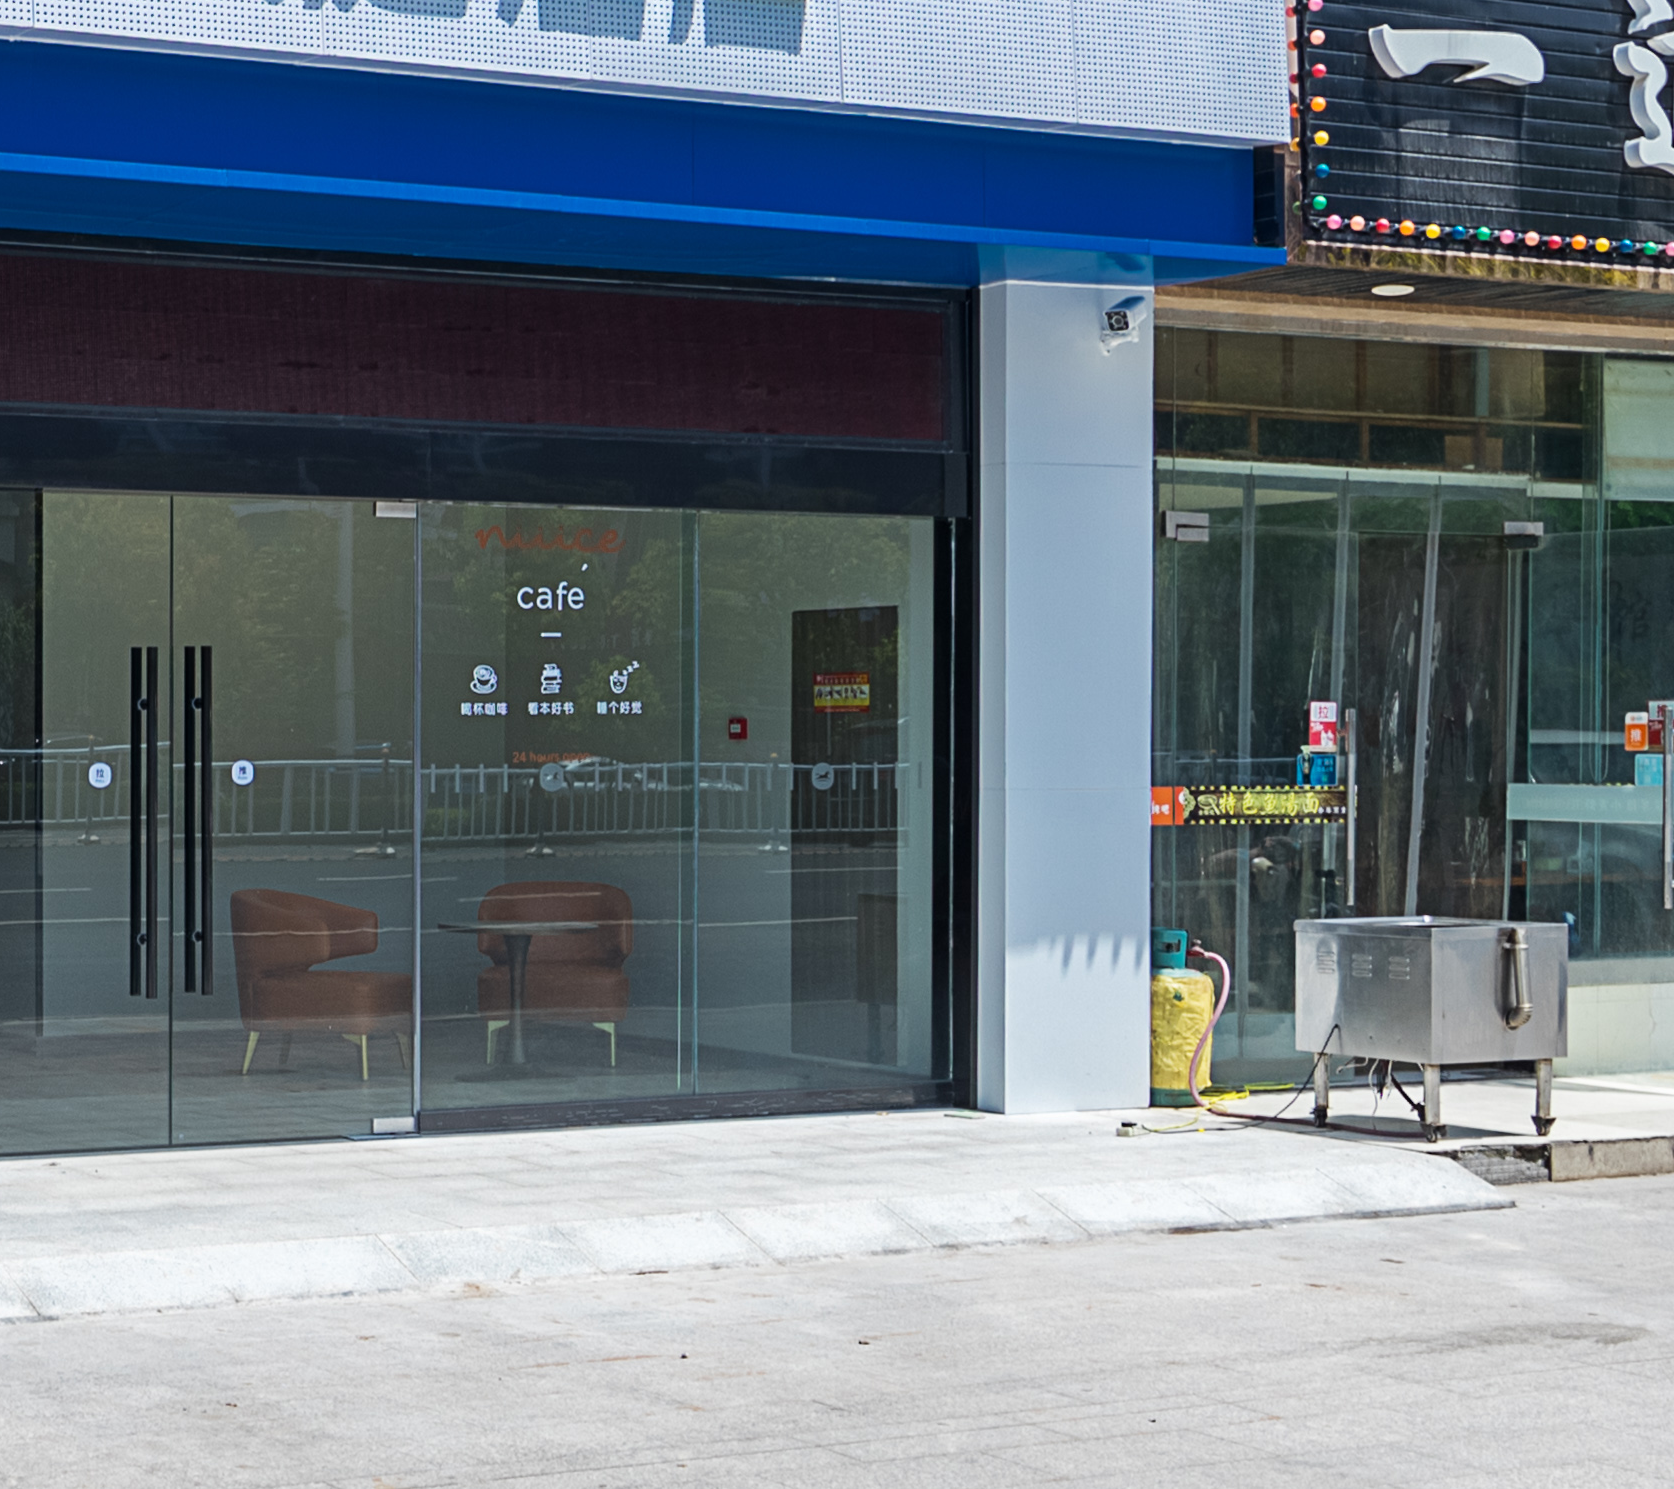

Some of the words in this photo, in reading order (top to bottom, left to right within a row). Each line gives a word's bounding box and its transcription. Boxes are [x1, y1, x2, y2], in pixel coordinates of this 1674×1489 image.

[528, 701, 575, 715] 看本好书
[512, 751, 526, 763] 24
[529, 751, 560, 763] hours
